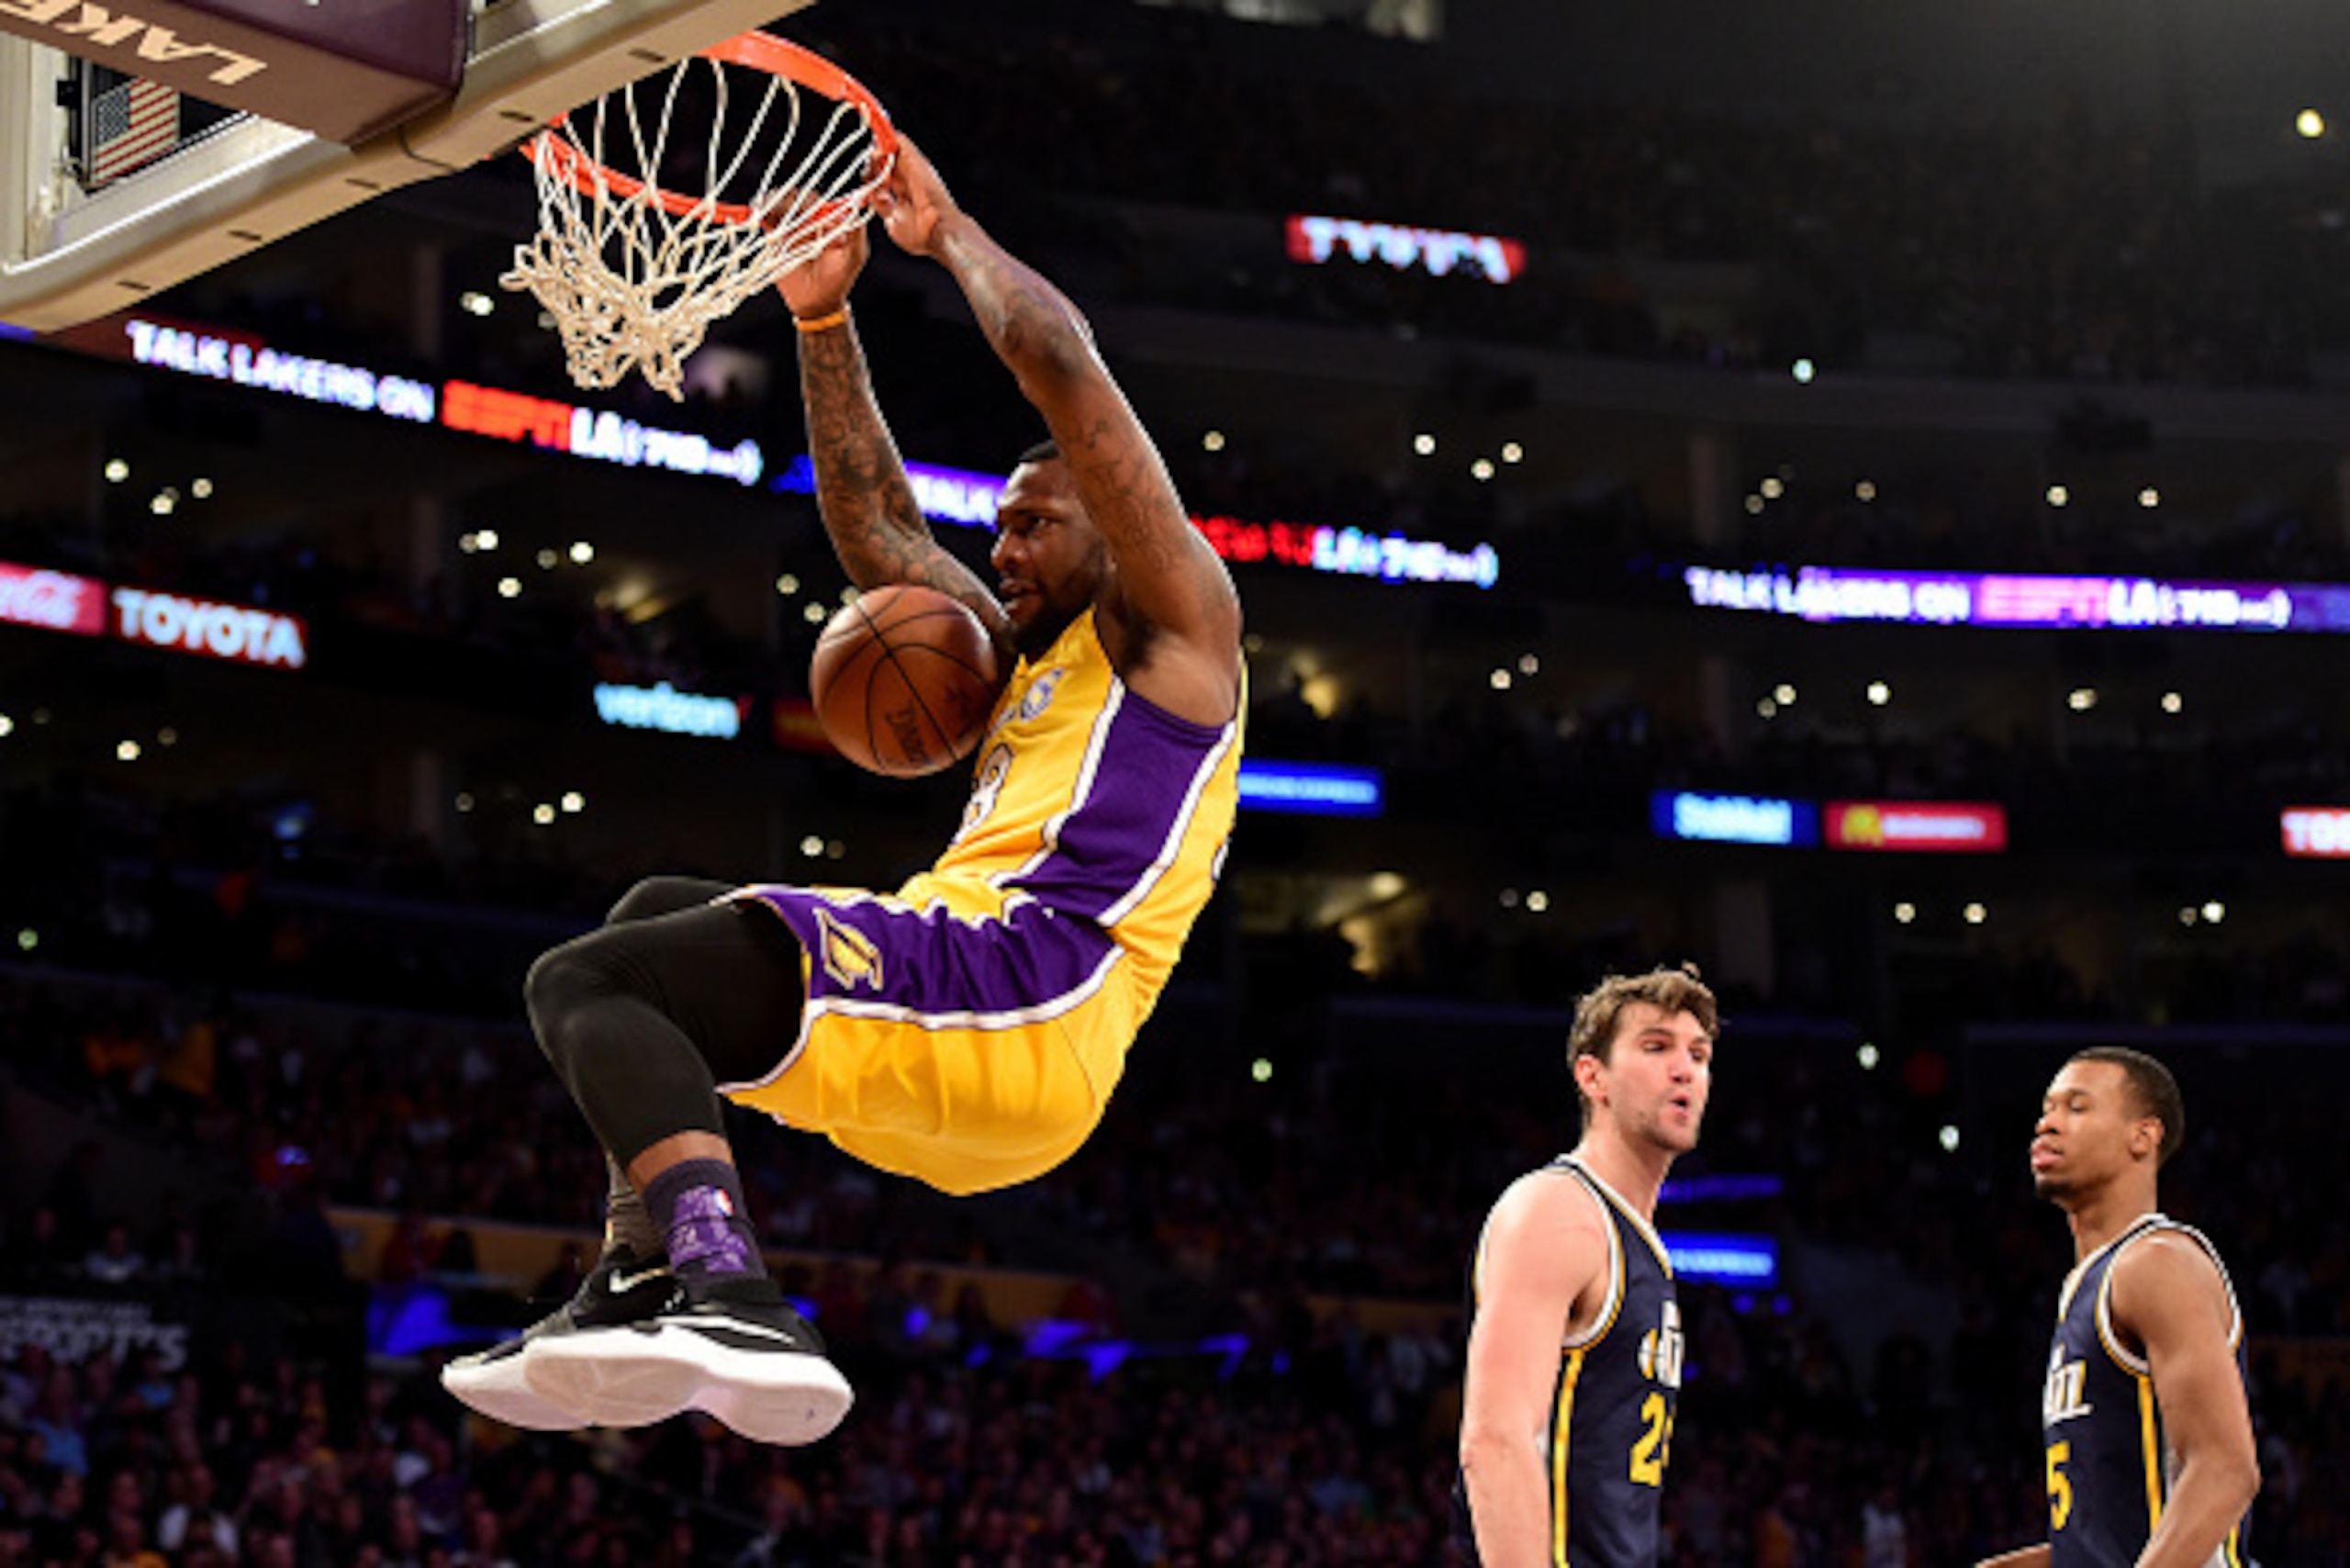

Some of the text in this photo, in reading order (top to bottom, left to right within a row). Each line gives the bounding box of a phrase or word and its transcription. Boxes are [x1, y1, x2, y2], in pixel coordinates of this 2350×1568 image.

[127, 321, 229, 377] TALK
[231, 345, 375, 409] LAKERS
[376, 376, 433, 421] ON
[112, 587, 305, 668] TOYOTA
[1686, 567, 1772, 608] TALK
[1914, 582, 1970, 622] ON
[593, 680, 740, 740] verizon
